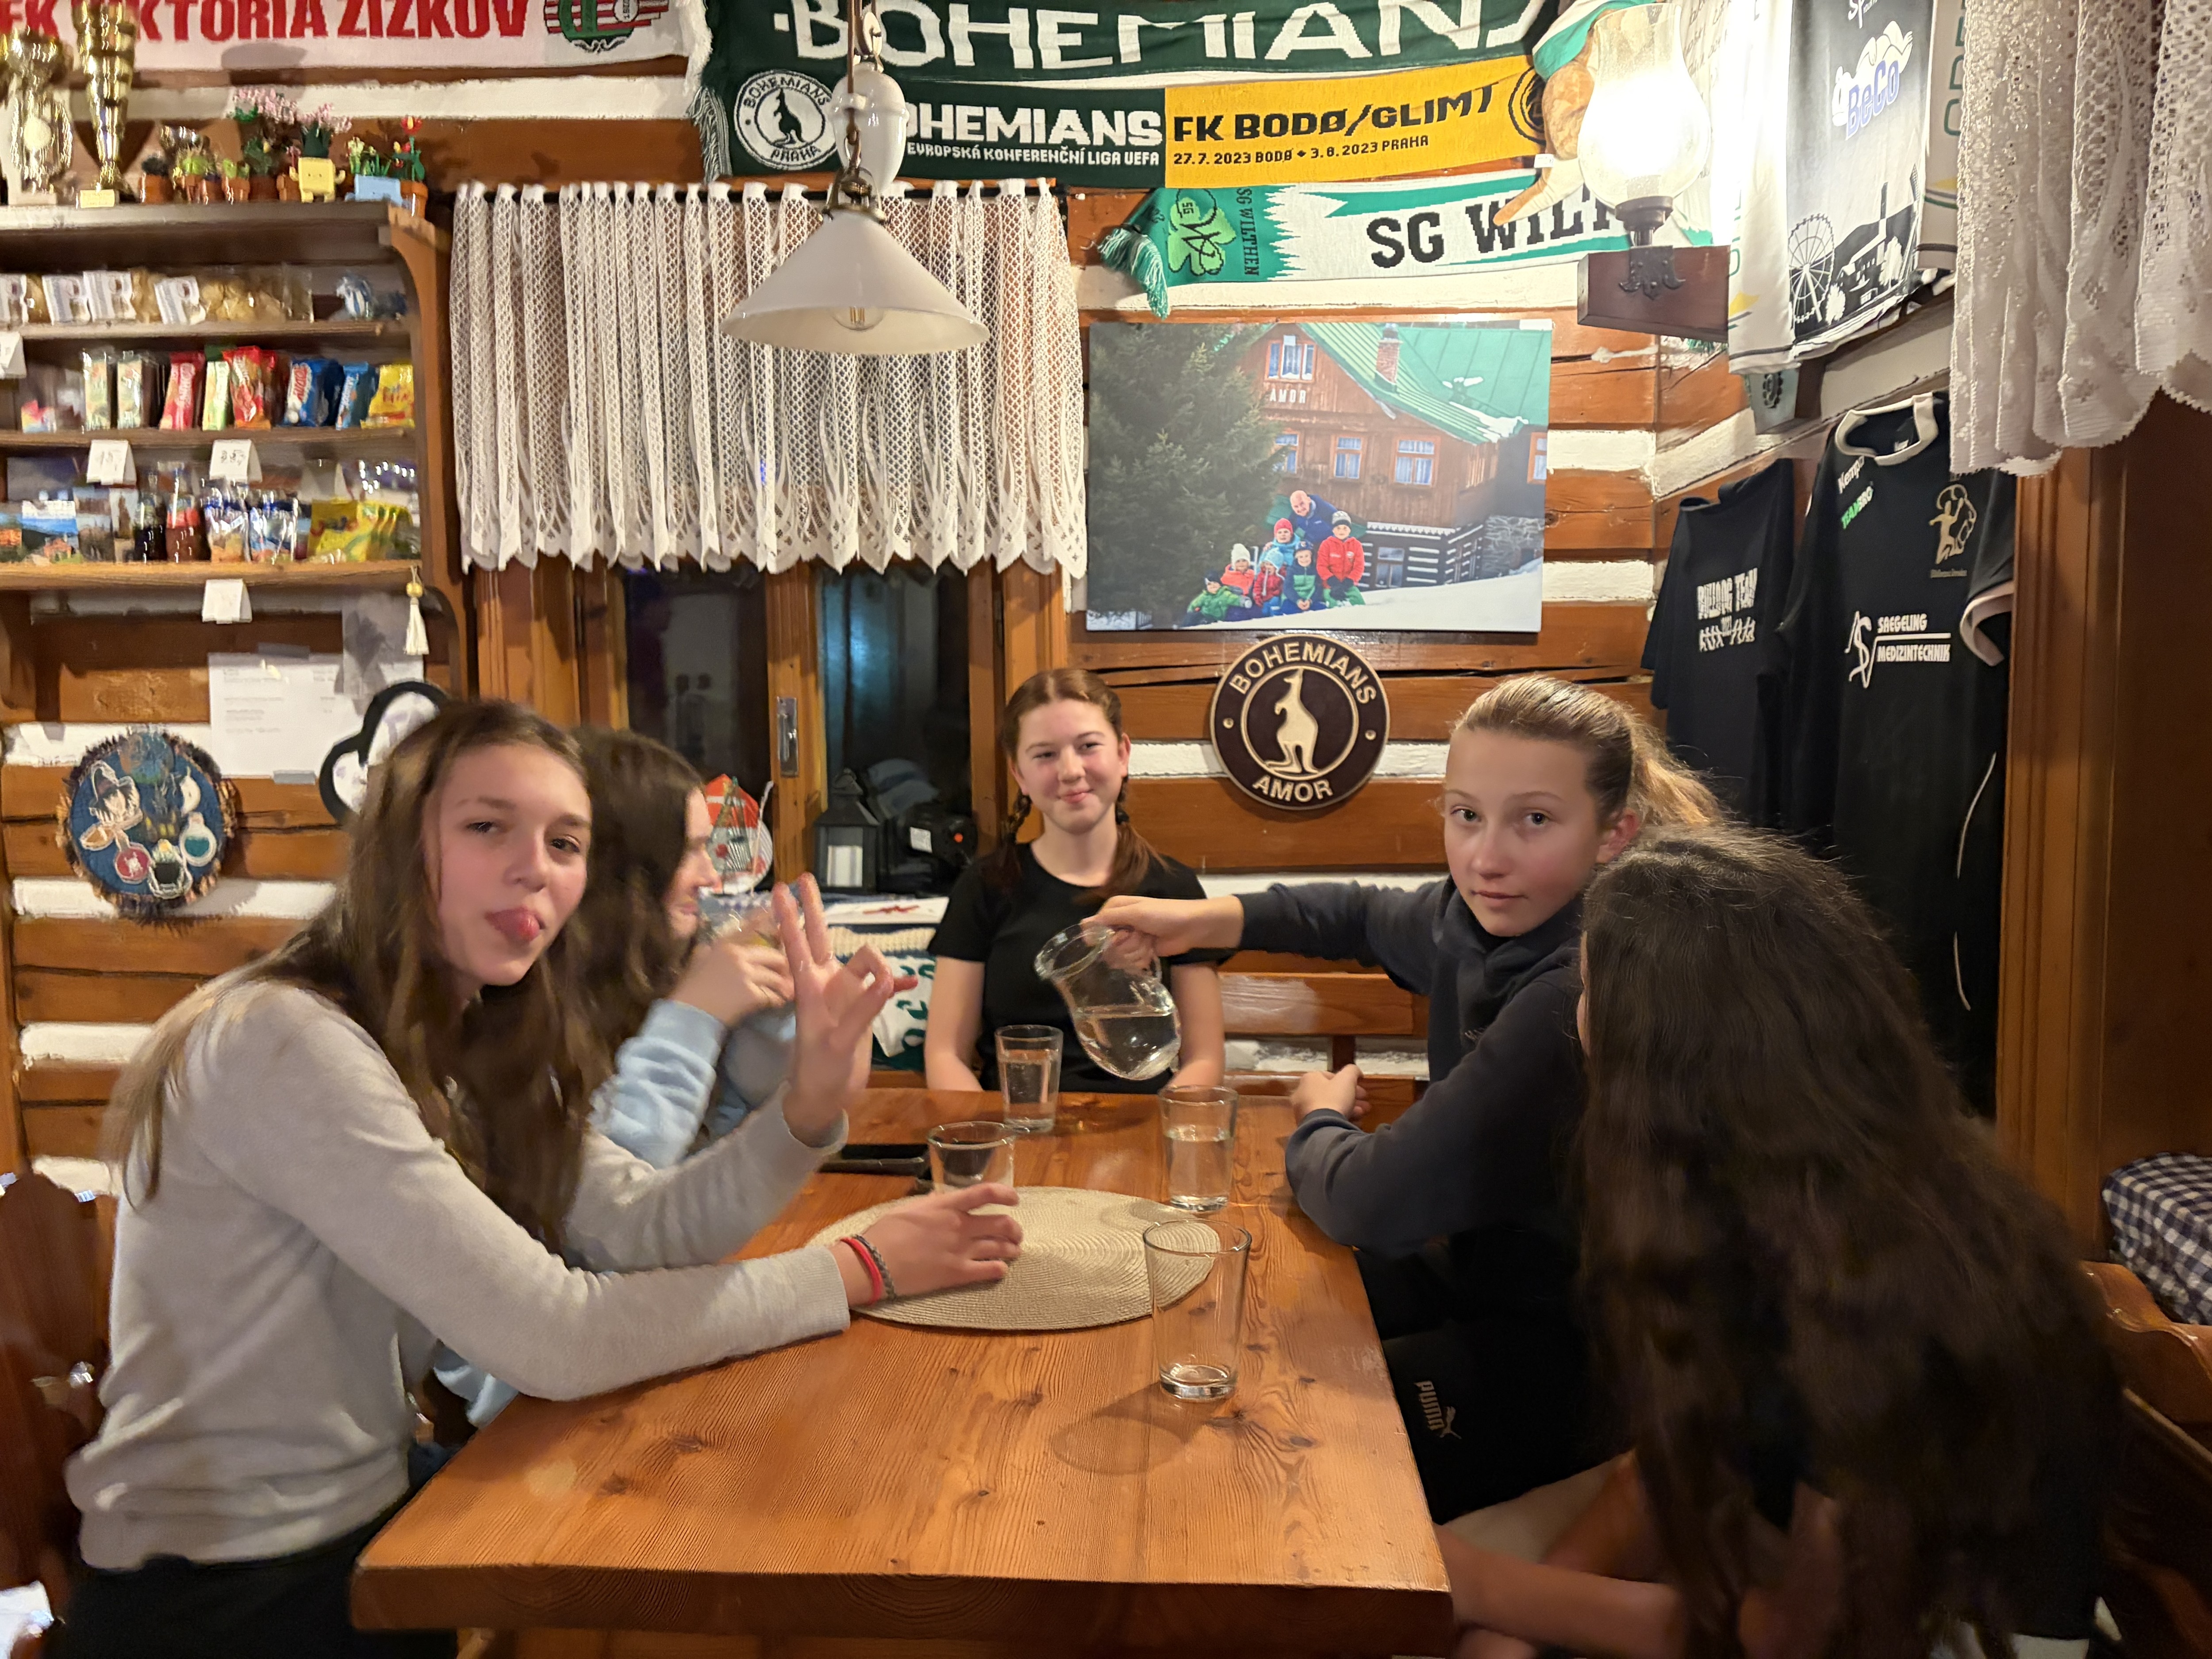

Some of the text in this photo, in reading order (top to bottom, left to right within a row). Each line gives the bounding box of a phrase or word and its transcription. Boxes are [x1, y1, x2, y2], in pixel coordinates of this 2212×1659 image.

[0, 0, 59, 38] FK
[905, 102, 1163, 146] HEMIANS
[1174, 114, 1224, 142] FK
[770, 145, 822, 163] PRAHA
[907, 142, 1159, 165] EVROPSKÁ KONFERENČNÍ LIGA UEFA
[1382, 134, 1429, 151] PRAHA
[1236, 188, 1260, 276] SG WILTHEN
[1366, 211, 1444, 268] SG
[1877, 613, 1928, 634] SAEGELING
[1877, 644, 1951, 662] MEDIZINTECHNIK
[1229, 641, 1376, 704] BOHEMIANS
[1252, 775, 1333, 802] AMOR
[1414, 1380, 1445, 1431] PUMA
